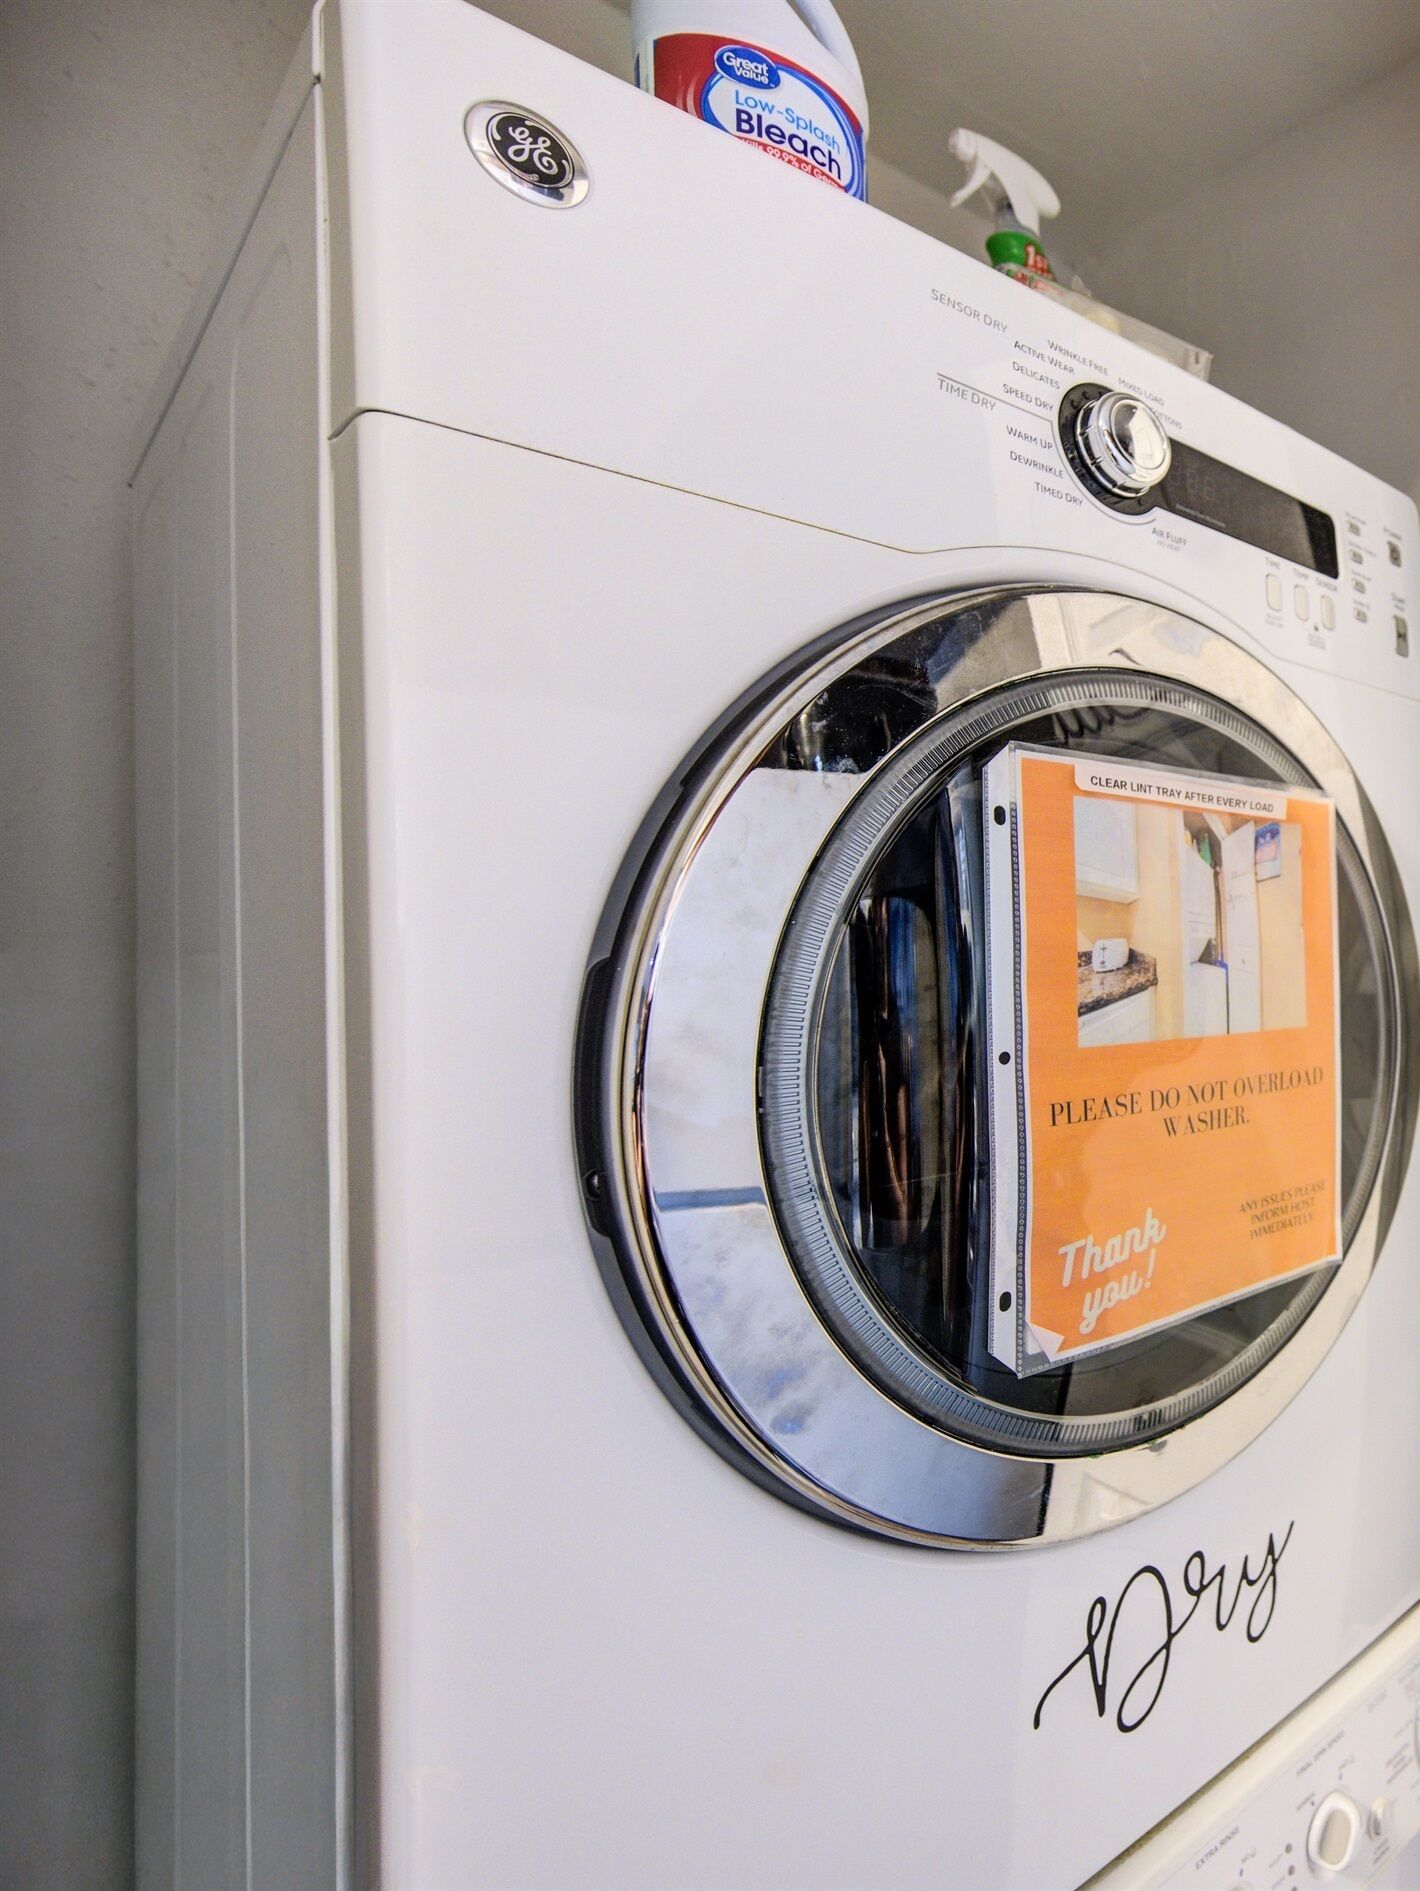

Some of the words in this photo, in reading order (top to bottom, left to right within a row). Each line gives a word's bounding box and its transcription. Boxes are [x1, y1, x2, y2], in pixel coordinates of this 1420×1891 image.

[722, 51, 769, 77] Great
[734, 67, 769, 85] Value
[735, 89, 841, 154] Low-Splash
[735, 107, 841, 180] Bleach
[930, 288, 981, 321] SENSOR
[983, 313, 1008, 334] DRY
[1013, 340, 1046, 362] ACTIVE
[1047, 354, 1076, 376] WEAR
[1047, 340, 1087, 367] WRINKLE
[1088, 360, 1110, 377] FREE
[1012, 361, 1061, 390] DELICATES
[937, 377, 969, 400] TIME
[971, 391, 997, 412] DRY
[1002, 383, 1033, 404] SPEED
[1034, 396, 1055, 412] DRY
[1006, 424, 1038, 445] WARM
[1040, 439, 1054, 450] UP
[1009, 450, 1065, 479] DEWRINKLE
[1034, 481, 1064, 500] TIMED
[1065, 493, 1084, 506] DRY
[1090, 775, 1128, 791] CLEAR
[1130, 781, 1153, 794] LINT
[1155, 786, 1182, 800] TRAY
[1184, 791, 1214, 805] AFTER
[1216, 796, 1248, 810] EVERY
[1249, 802, 1275, 813] LOAD
[1049, 1091, 1143, 1127] PLEASE
[1150, 1086, 1181, 1112] DO
[1187, 1079, 1229, 1106] NOT
[1232, 1066, 1325, 1098] OVERLOAD
[1162, 1104, 1250, 1138] WASHER.
[1239, 1199, 1259, 1213] ANY
[1260, 1188, 1294, 1208] ISSUES
[1294, 1179, 1326, 1199] PLEASE
[1250, 1204, 1289, 1225] INFORM
[1291, 1196, 1316, 1213] HOST
[1250, 1211, 1314, 1241] IMMEDIATELY
[1058, 1207, 1168, 1288] Thank
[1078, 1247, 1157, 1335] you!
[1033, 1520, 1295, 1734] Dry
